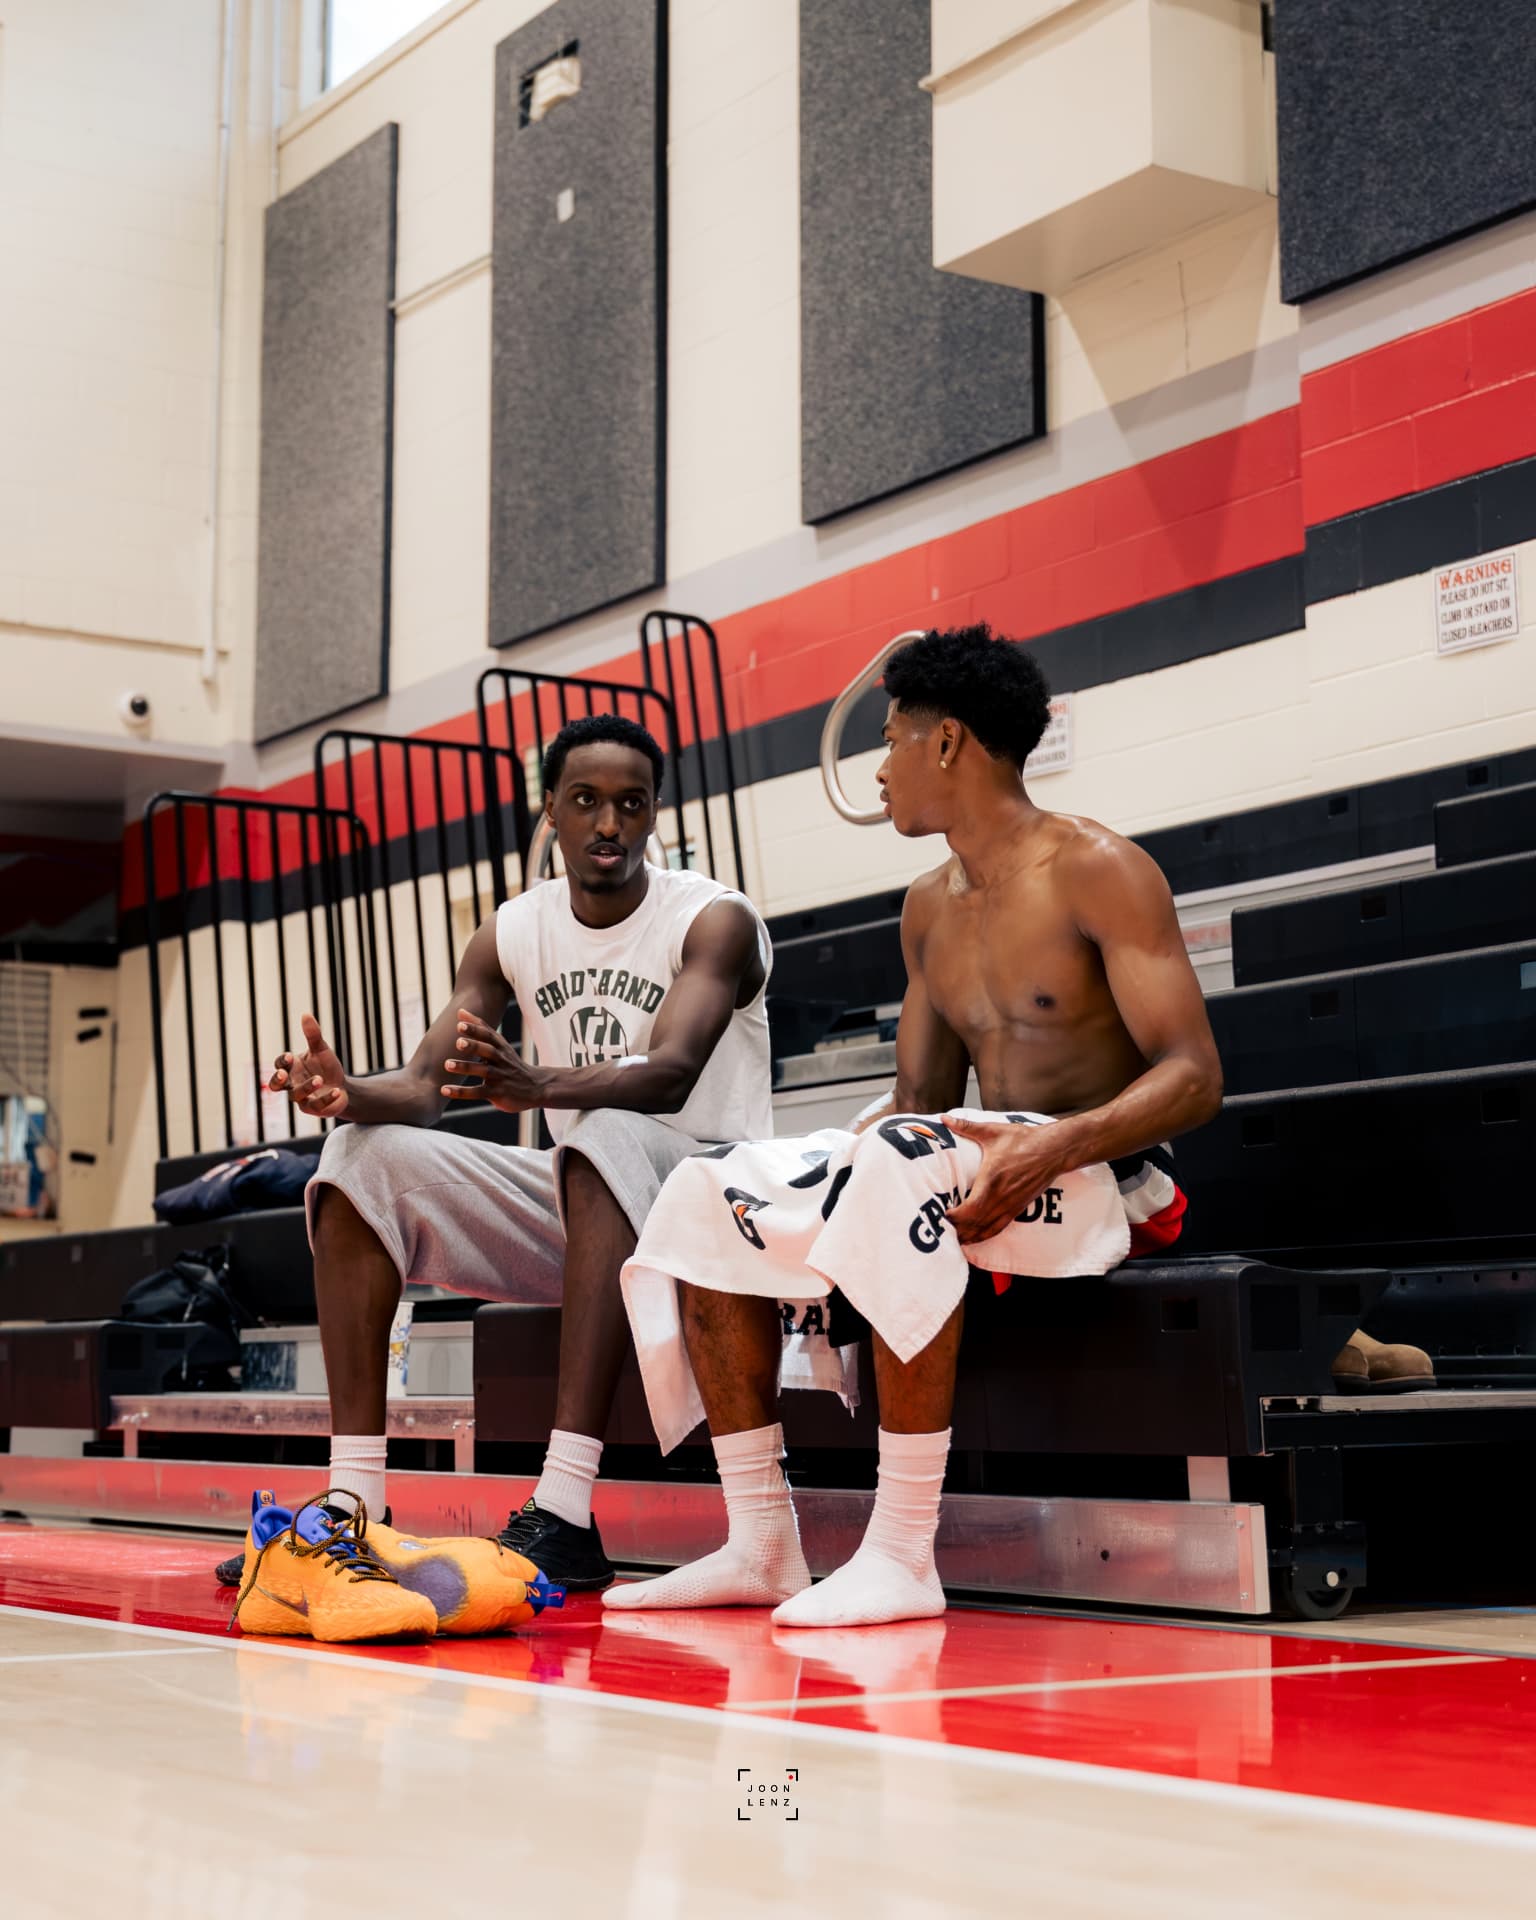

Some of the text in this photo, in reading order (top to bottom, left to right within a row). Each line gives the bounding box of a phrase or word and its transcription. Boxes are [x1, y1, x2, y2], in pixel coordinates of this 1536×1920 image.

[1439, 558, 1513, 590] WARNING
[1440, 588, 1469, 606] PLEASE
[1470, 585, 1479, 598] DO
[1481, 581, 1494, 596] NOT
[1441, 596, 1511, 625] CLIMB OR STAND ON
[1441, 615, 1513, 645] CLOSED BLEACHERS
